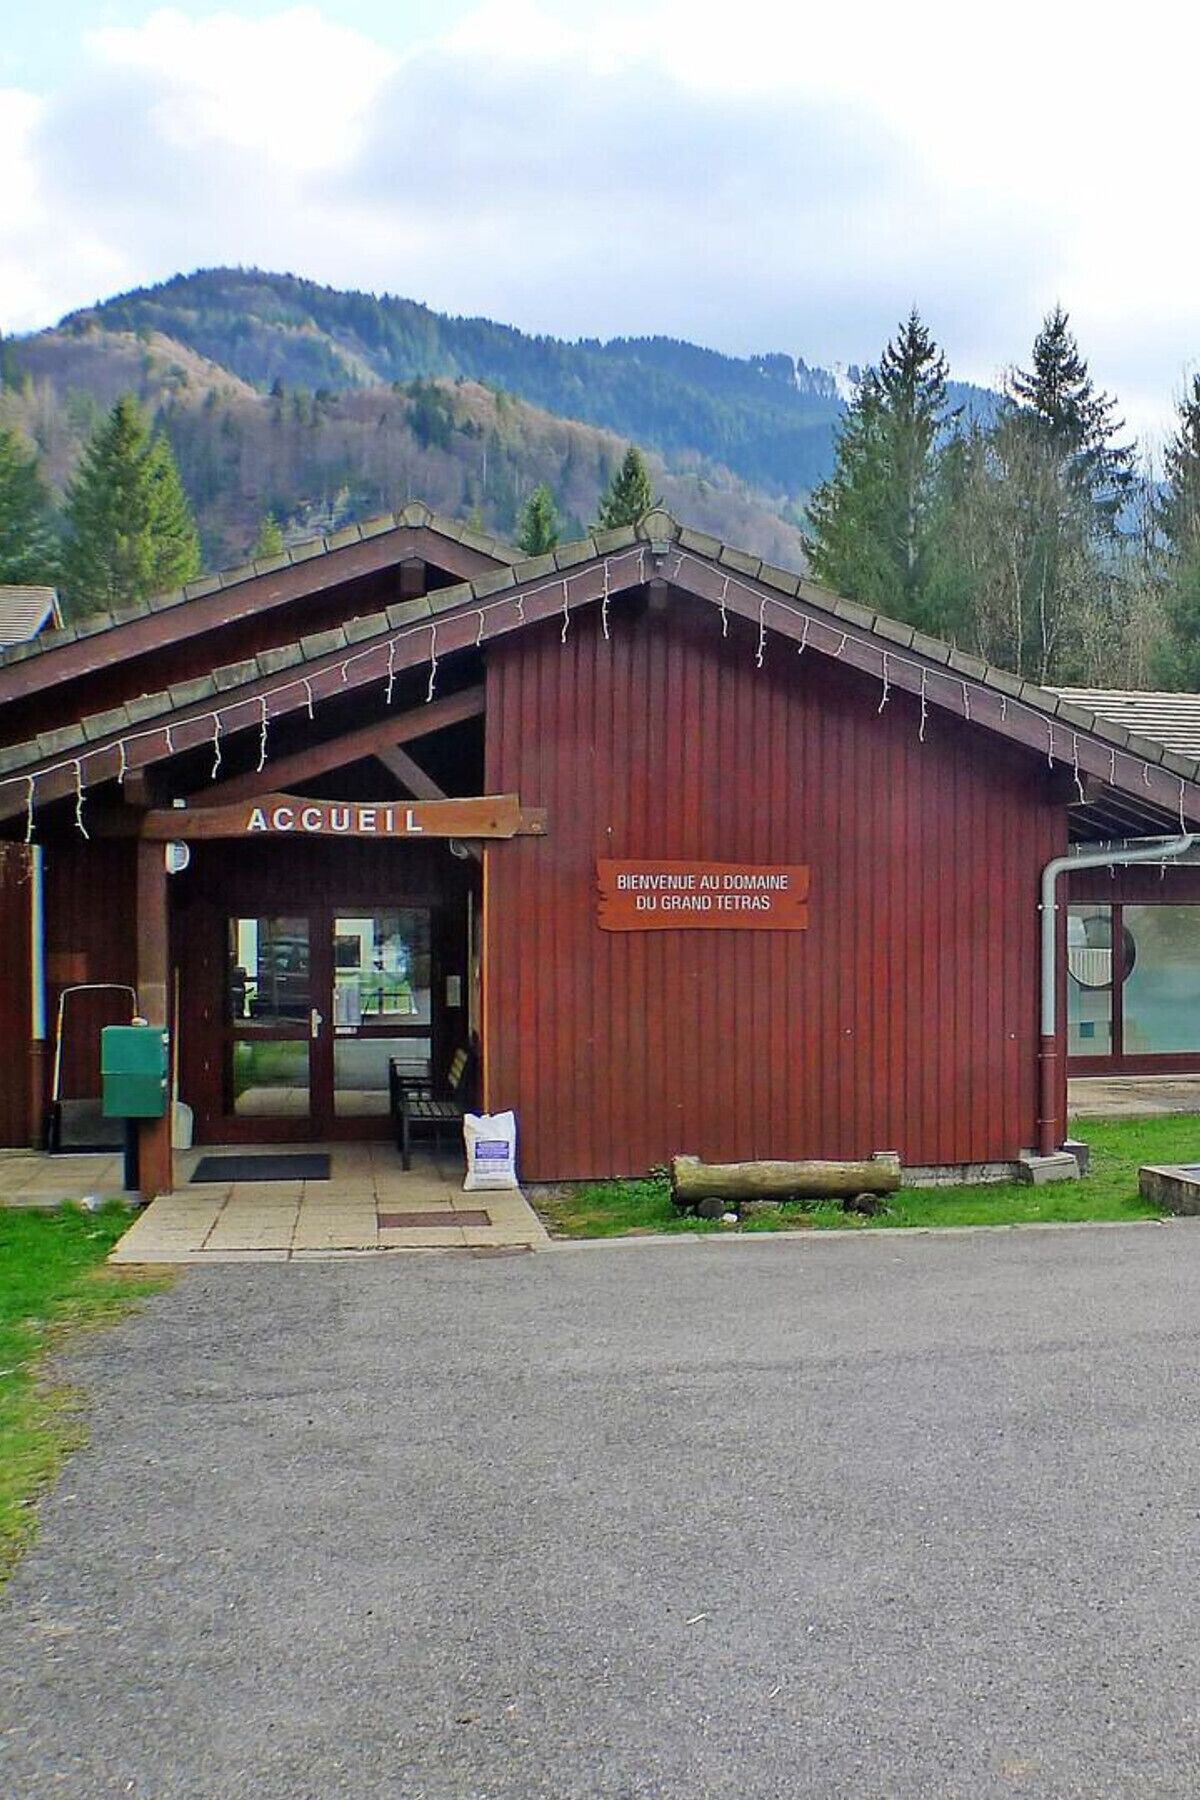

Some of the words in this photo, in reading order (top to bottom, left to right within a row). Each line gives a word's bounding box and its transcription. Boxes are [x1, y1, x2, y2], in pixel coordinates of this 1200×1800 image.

[246, 807, 423, 832] ACCUEIL
[616, 874, 697, 890] BIENVENUE
[699, 874, 720, 890] AU
[723, 874, 789, 890] DOMAINE
[635, 895, 657, 910] DU
[660, 895, 712, 910] GRAND
[715, 895, 771, 911] TETRAS
